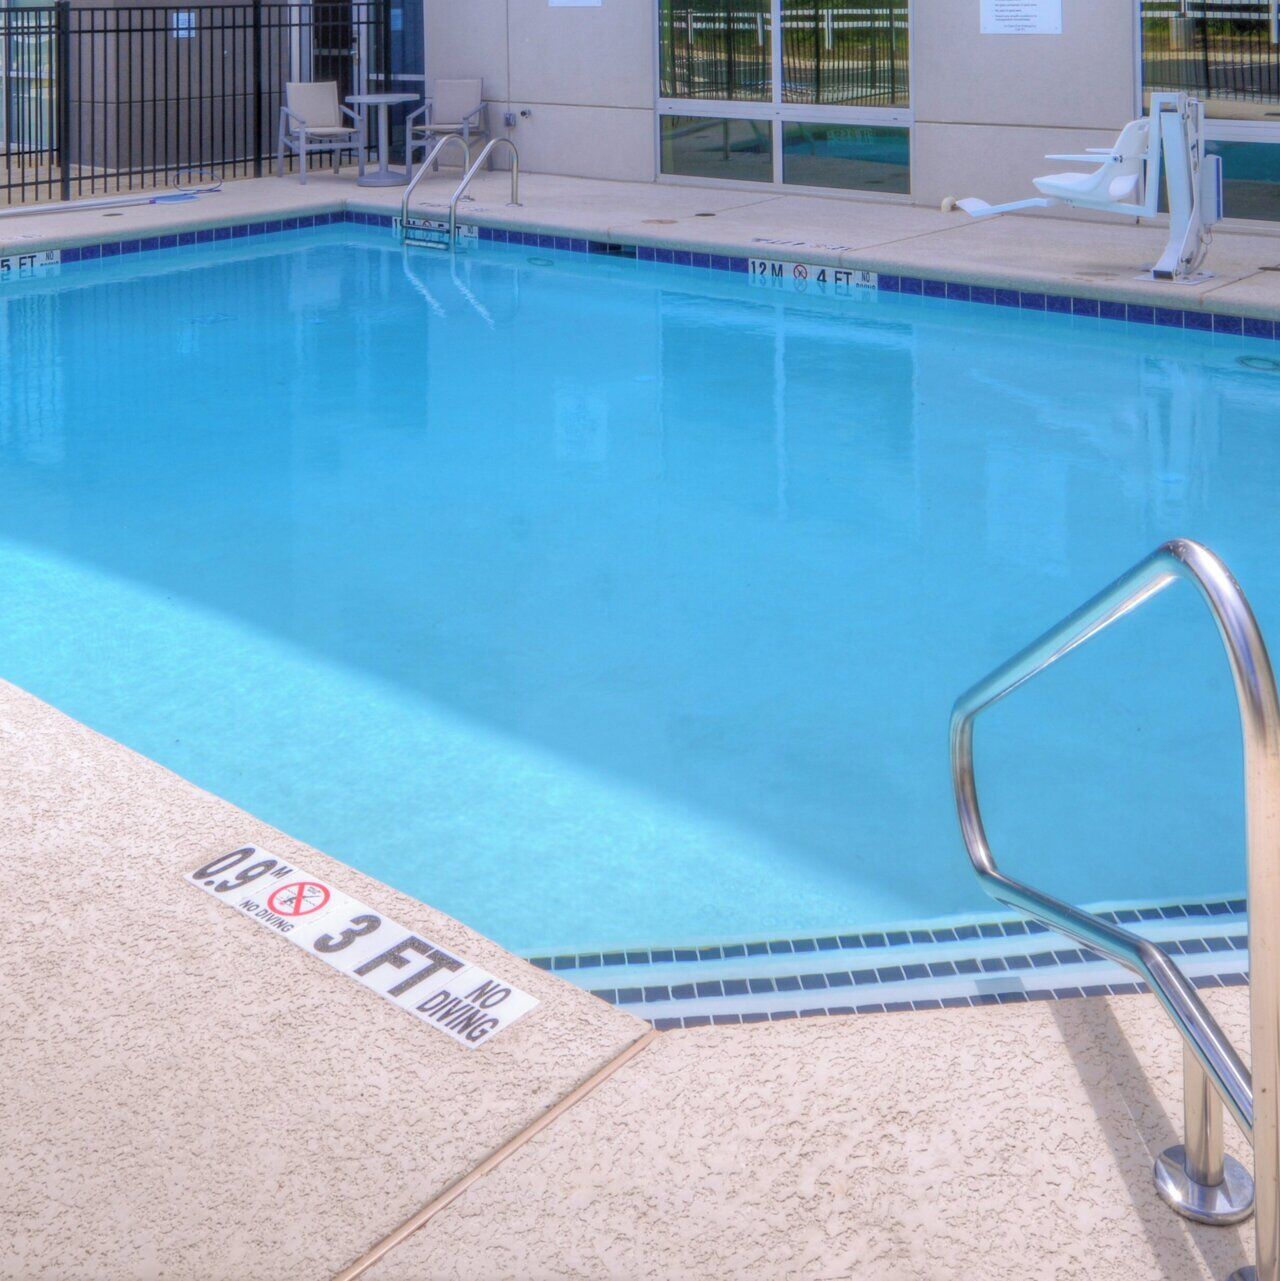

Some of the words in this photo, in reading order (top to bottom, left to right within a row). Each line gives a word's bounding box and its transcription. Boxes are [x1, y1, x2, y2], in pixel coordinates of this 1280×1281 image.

[18, 255, 37, 269] FT
[816, 269, 827, 282] 4
[834, 271, 852, 286] FT
[239, 897, 260, 916] NO
[255, 907, 295, 933] DIVING
[313, 914, 381, 954] 3
[353, 936, 465, 998] FT
[469, 979, 511, 1011] NO
[416, 990, 500, 1043] DIVING
